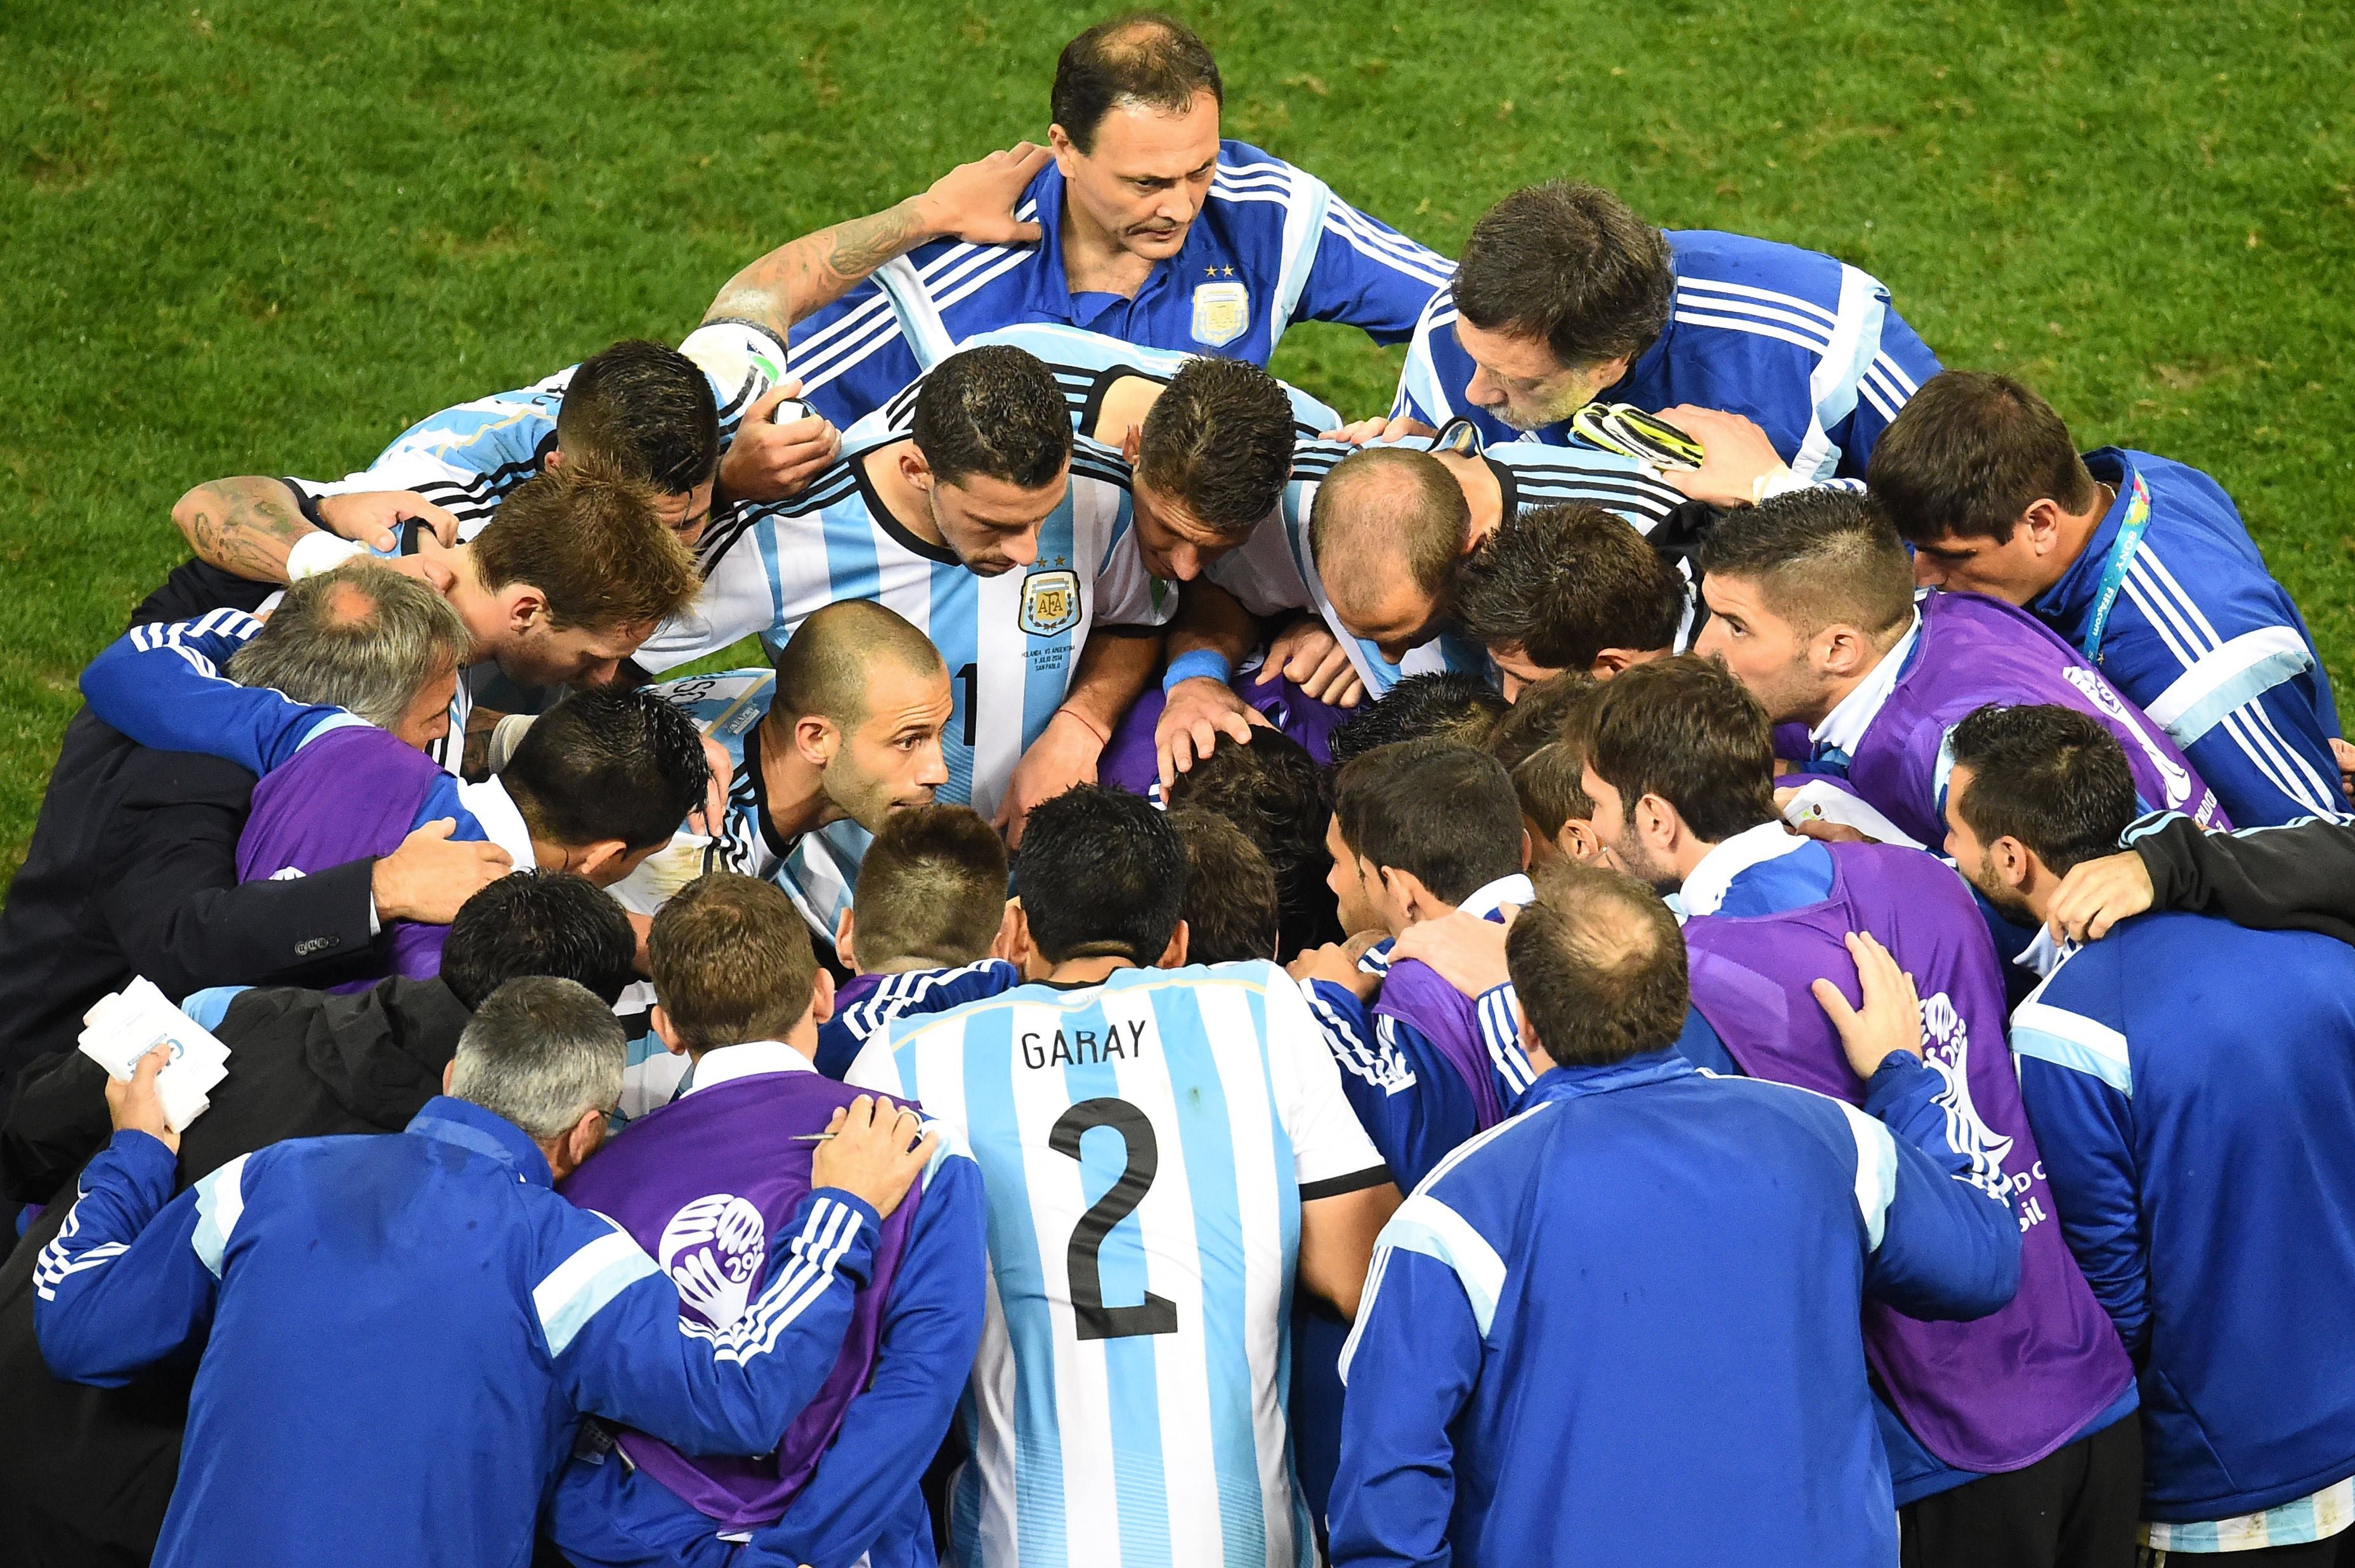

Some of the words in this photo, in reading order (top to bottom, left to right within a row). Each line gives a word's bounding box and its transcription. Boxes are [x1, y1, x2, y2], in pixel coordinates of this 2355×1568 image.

[2115, 530, 2137, 572] SONY
[1038, 592, 1063, 616] AFA
[2092, 586, 2115, 637] FIFA.com
[1022, 650, 1041, 658] HOLANDA
[1052, 645, 1075, 653] ARGENTINA
[1038, 655, 1051, 663] JULIO
[955, 663, 977, 746] 1
[2191, 799, 2213, 826] ORLD
[1021, 1020, 1146, 1069] GARAY
[1048, 1097, 1178, 1341] 2
